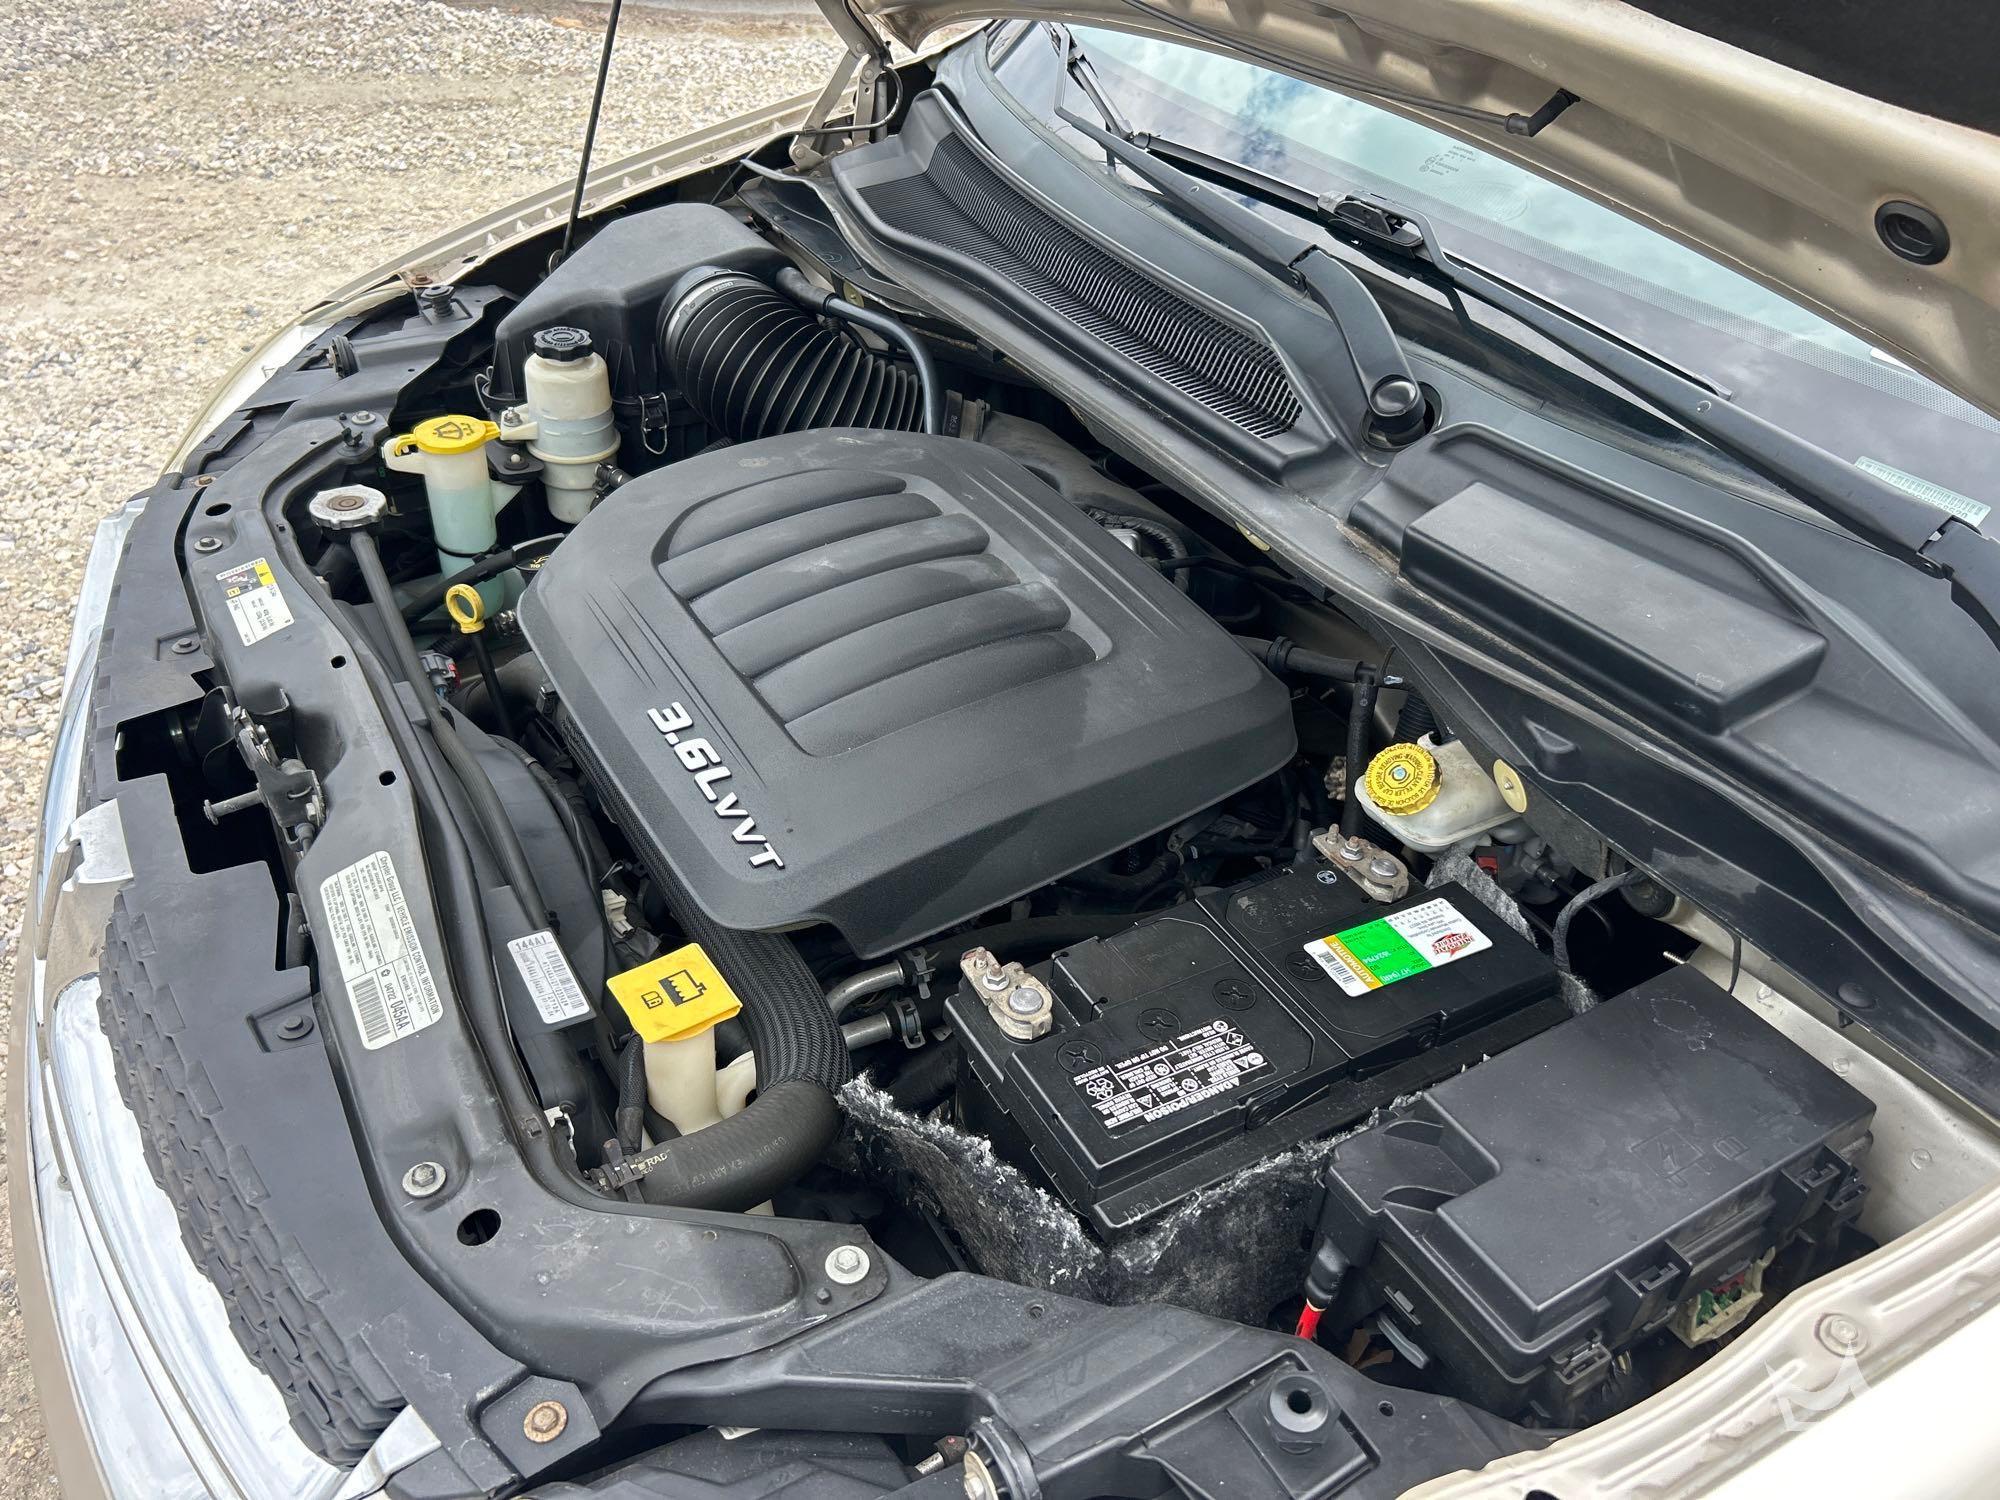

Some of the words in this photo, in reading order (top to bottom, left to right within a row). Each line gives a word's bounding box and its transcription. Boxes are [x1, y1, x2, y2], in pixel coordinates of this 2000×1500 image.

[385, 875, 398, 892] Group
[391, 890, 401, 902] LLC
[398, 905, 409, 927] VEHICLE
[404, 925, 417, 952] EMISSION
[413, 950, 426, 977] CONTROL
[422, 975, 439, 1015] INFORMATION
[1328, 941, 1374, 983] AUTOMOTIVE
[1399, 966, 1411, 975] H7
[1381, 970, 1401, 982] (94R)
[389, 999, 410, 1031] 045AA
[1142, 1079, 1233, 1123] DANGER/POISON
